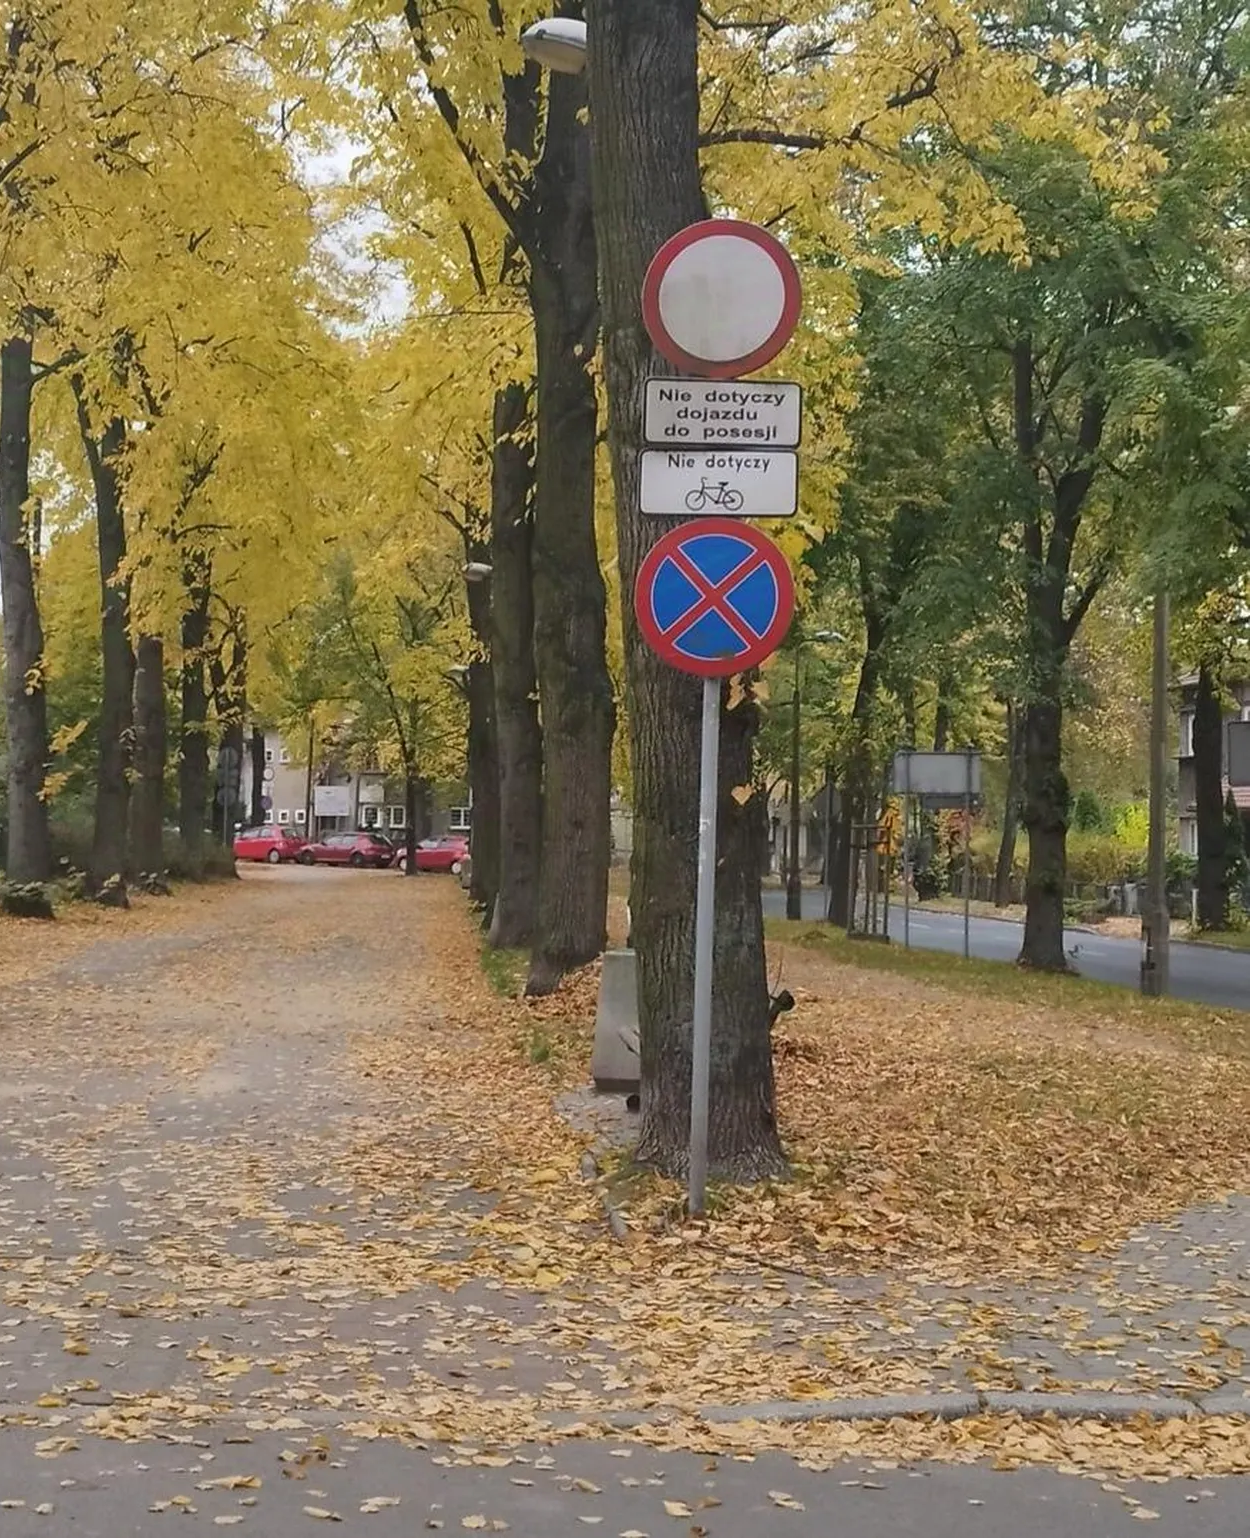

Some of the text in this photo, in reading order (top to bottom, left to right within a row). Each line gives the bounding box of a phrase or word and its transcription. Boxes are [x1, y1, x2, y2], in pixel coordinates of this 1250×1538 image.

[659, 388, 785, 406] Nie dotyczy
[676, 407, 758, 422] dojazdu
[664, 424, 777, 441] do posesji
[668, 454, 771, 473] Nie dotyczy
